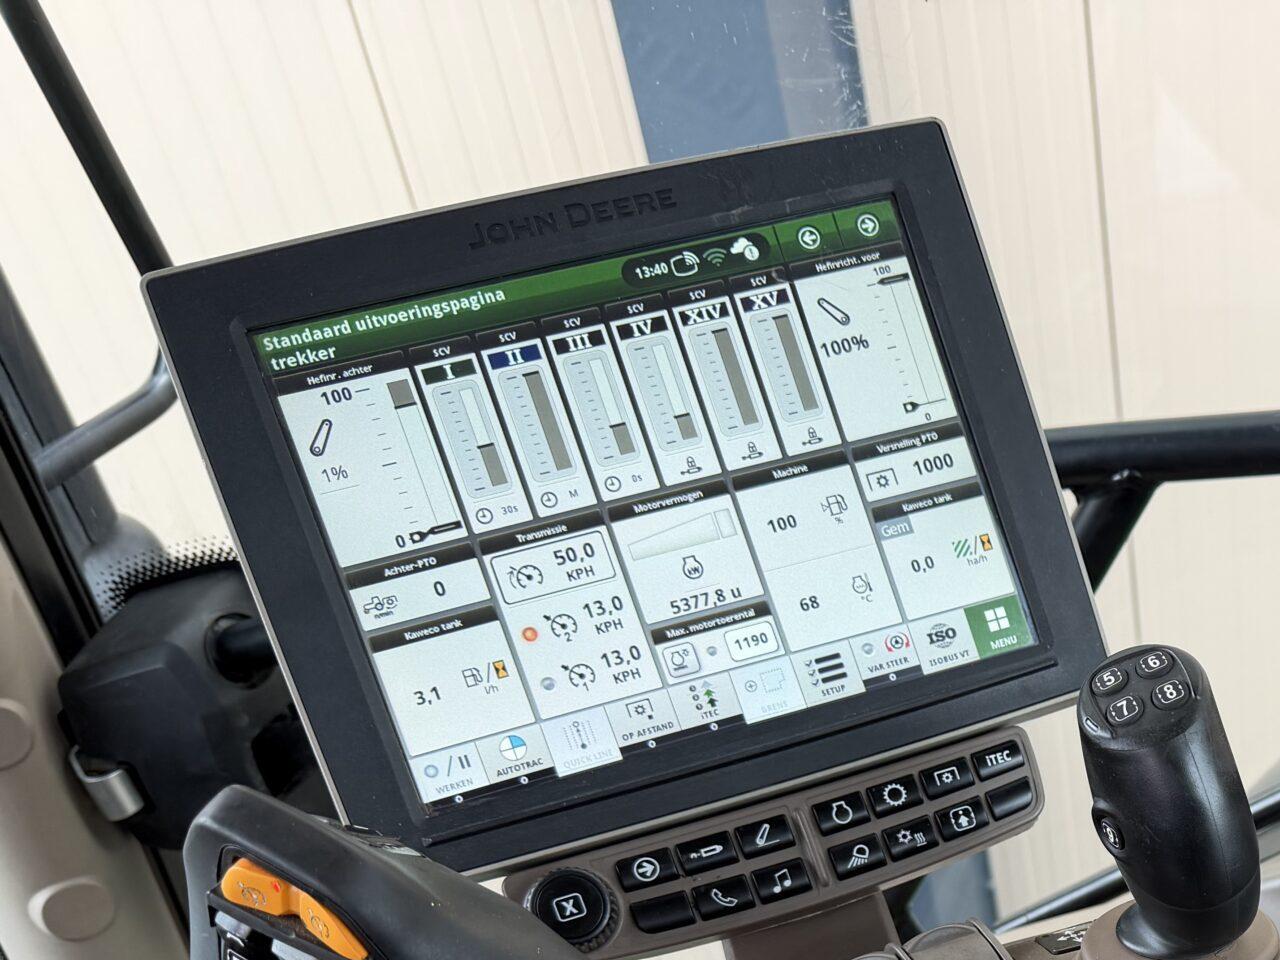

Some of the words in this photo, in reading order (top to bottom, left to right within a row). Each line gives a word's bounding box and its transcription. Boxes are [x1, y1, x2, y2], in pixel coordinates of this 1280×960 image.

[469, 212, 555, 249] JOHN
[565, 187, 677, 228] DEERE
[861, 252, 880, 261] voor
[634, 262, 668, 280] 13:40
[873, 265, 891, 276] 100
[751, 275, 767, 286] SCV
[690, 288, 706, 300] SCV
[749, 290, 778, 309] XV
[628, 302, 644, 313] SCV
[684, 304, 721, 323] XIV
[263, 320, 351, 351] Standaard
[356, 288, 506, 332] uitvoeringspagina
[564, 317, 581, 328] SCV
[631, 319, 652, 336] IV
[499, 331, 517, 342] SCV
[566, 333, 593, 350] III
[433, 346, 451, 356] SCV
[820, 334, 869, 358] 100%
[271, 343, 336, 371] trekker
[505, 349, 525, 365] II
[343, 365, 373, 377] achter
[321, 387, 352, 405] 100
[772, 463, 808, 480] Machine
[912, 453, 954, 476] 1000
[321, 465, 349, 482] 1%
[633, 490, 704, 514] Motorvermogen
[902, 499, 933, 513] Kaweco
[934, 494, 953, 504] tank
[767, 514, 797, 533] 100
[881, 521, 910, 537] Gem
[396, 535, 406, 548] 0
[553, 542, 596, 567] 50,0
[384, 556, 437, 577] Achter-PTO
[911, 555, 935, 573] 0,0
[566, 565, 596, 582] KPH
[434, 581, 446, 597] 0
[582, 595, 624, 619] 13,0
[670, 588, 727, 615] 5377,8
[730, 587, 742, 599] u
[799, 595, 820, 612] 68
[403, 624, 440, 641] Kaweco
[441, 618, 463, 630] tank
[595, 618, 624, 635] KPH
[665, 625, 689, 639] Max.
[690, 608, 756, 633] motortoerental
[734, 632, 768, 650] 1190
[927, 627, 957, 645] ISO
[990, 635, 1018, 650] MENU
[600, 645, 642, 669] 13,0
[868, 664, 885, 673] VAR
[887, 656, 910, 669] STEER
[929, 652, 959, 667] ISOBUS
[1148, 656, 1160, 668] 6
[613, 667, 642, 684] KPH
[1102, 672, 1115, 686] 5
[413, 686, 442, 706] 3,1
[821, 684, 846, 697] SETUP
[1163, 684, 1177, 699] 8
[1117, 700, 1130, 716] 7
[622, 731, 636, 741] OP
[637, 721, 674, 738] AFSTAND
[986, 750, 1012, 767] iTEC
[497, 758, 543, 777] AUTOTRAC
[436, 778, 474, 794] WERKEN
